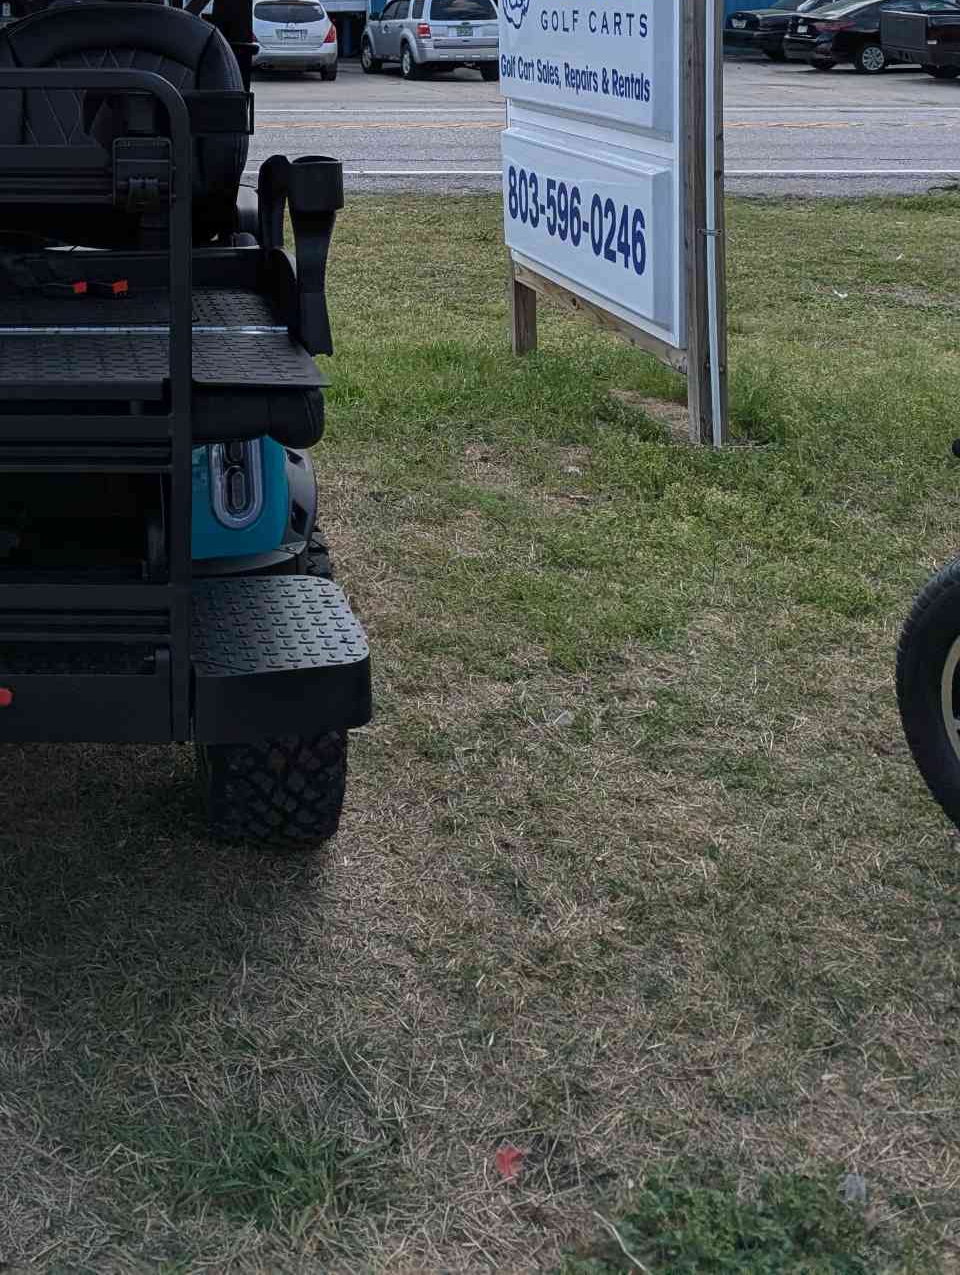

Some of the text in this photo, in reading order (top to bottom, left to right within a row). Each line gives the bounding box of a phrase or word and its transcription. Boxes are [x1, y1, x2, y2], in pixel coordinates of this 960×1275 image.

[540, 9, 648, 38] GOLF CARTS
[500, 53, 651, 103] Golf Cart Sales, Repairs & Rentals
[508, 165, 647, 276] 803-596-0246
